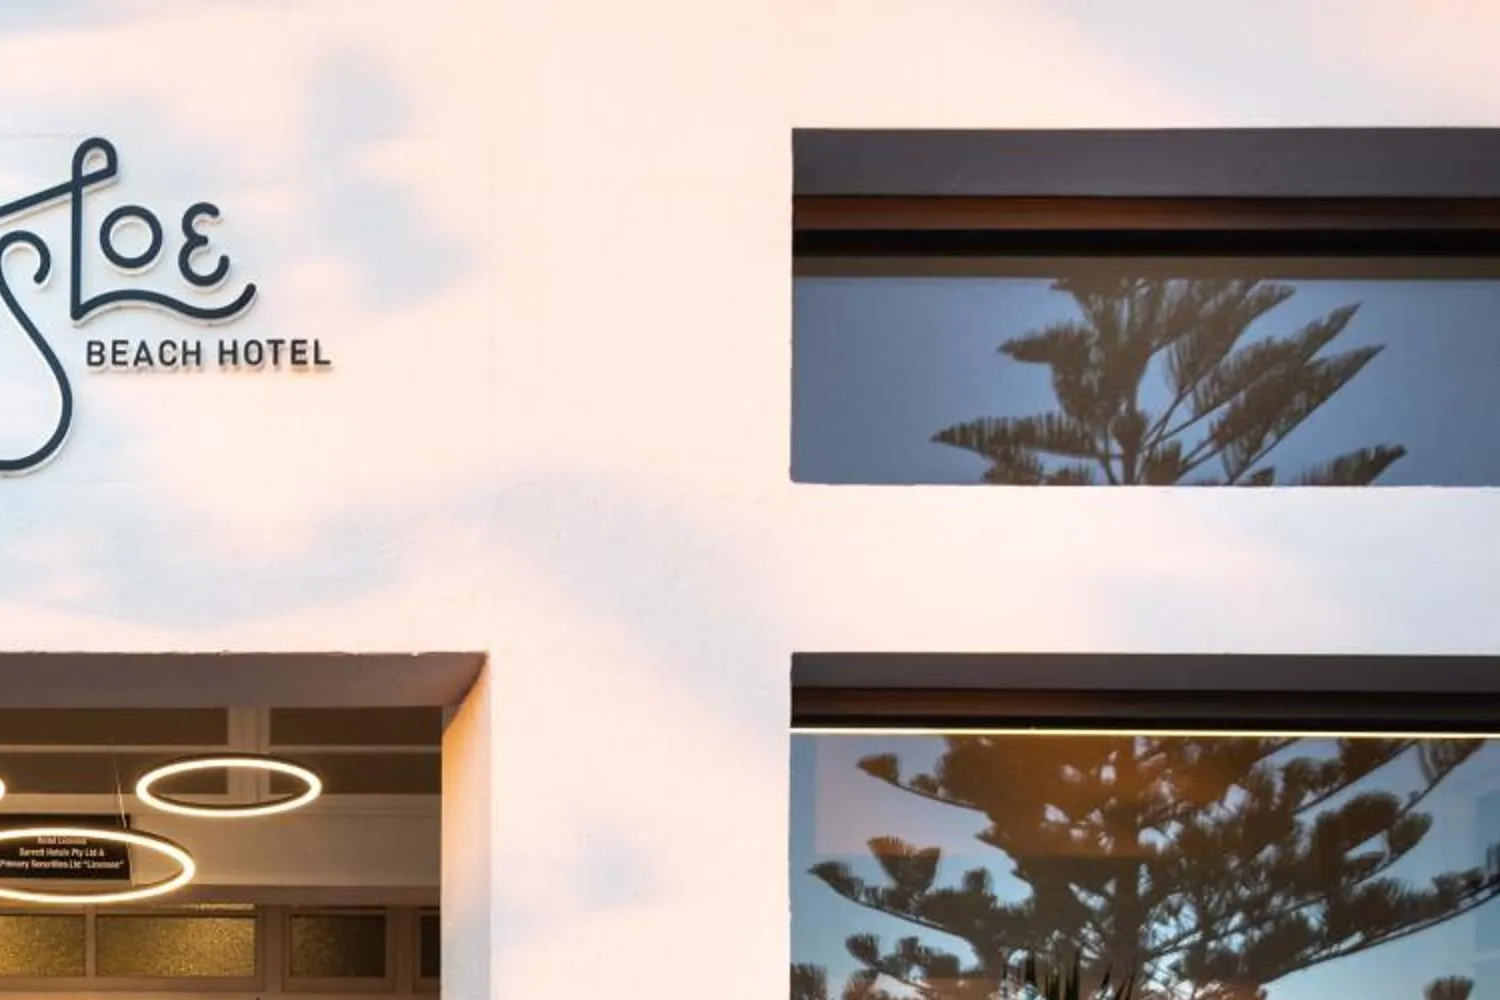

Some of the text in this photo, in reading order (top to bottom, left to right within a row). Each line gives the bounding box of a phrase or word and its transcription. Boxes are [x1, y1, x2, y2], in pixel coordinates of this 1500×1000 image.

[86, 339, 331, 367] BEACH HOTEL
[71, 847, 83, 859] Pty
